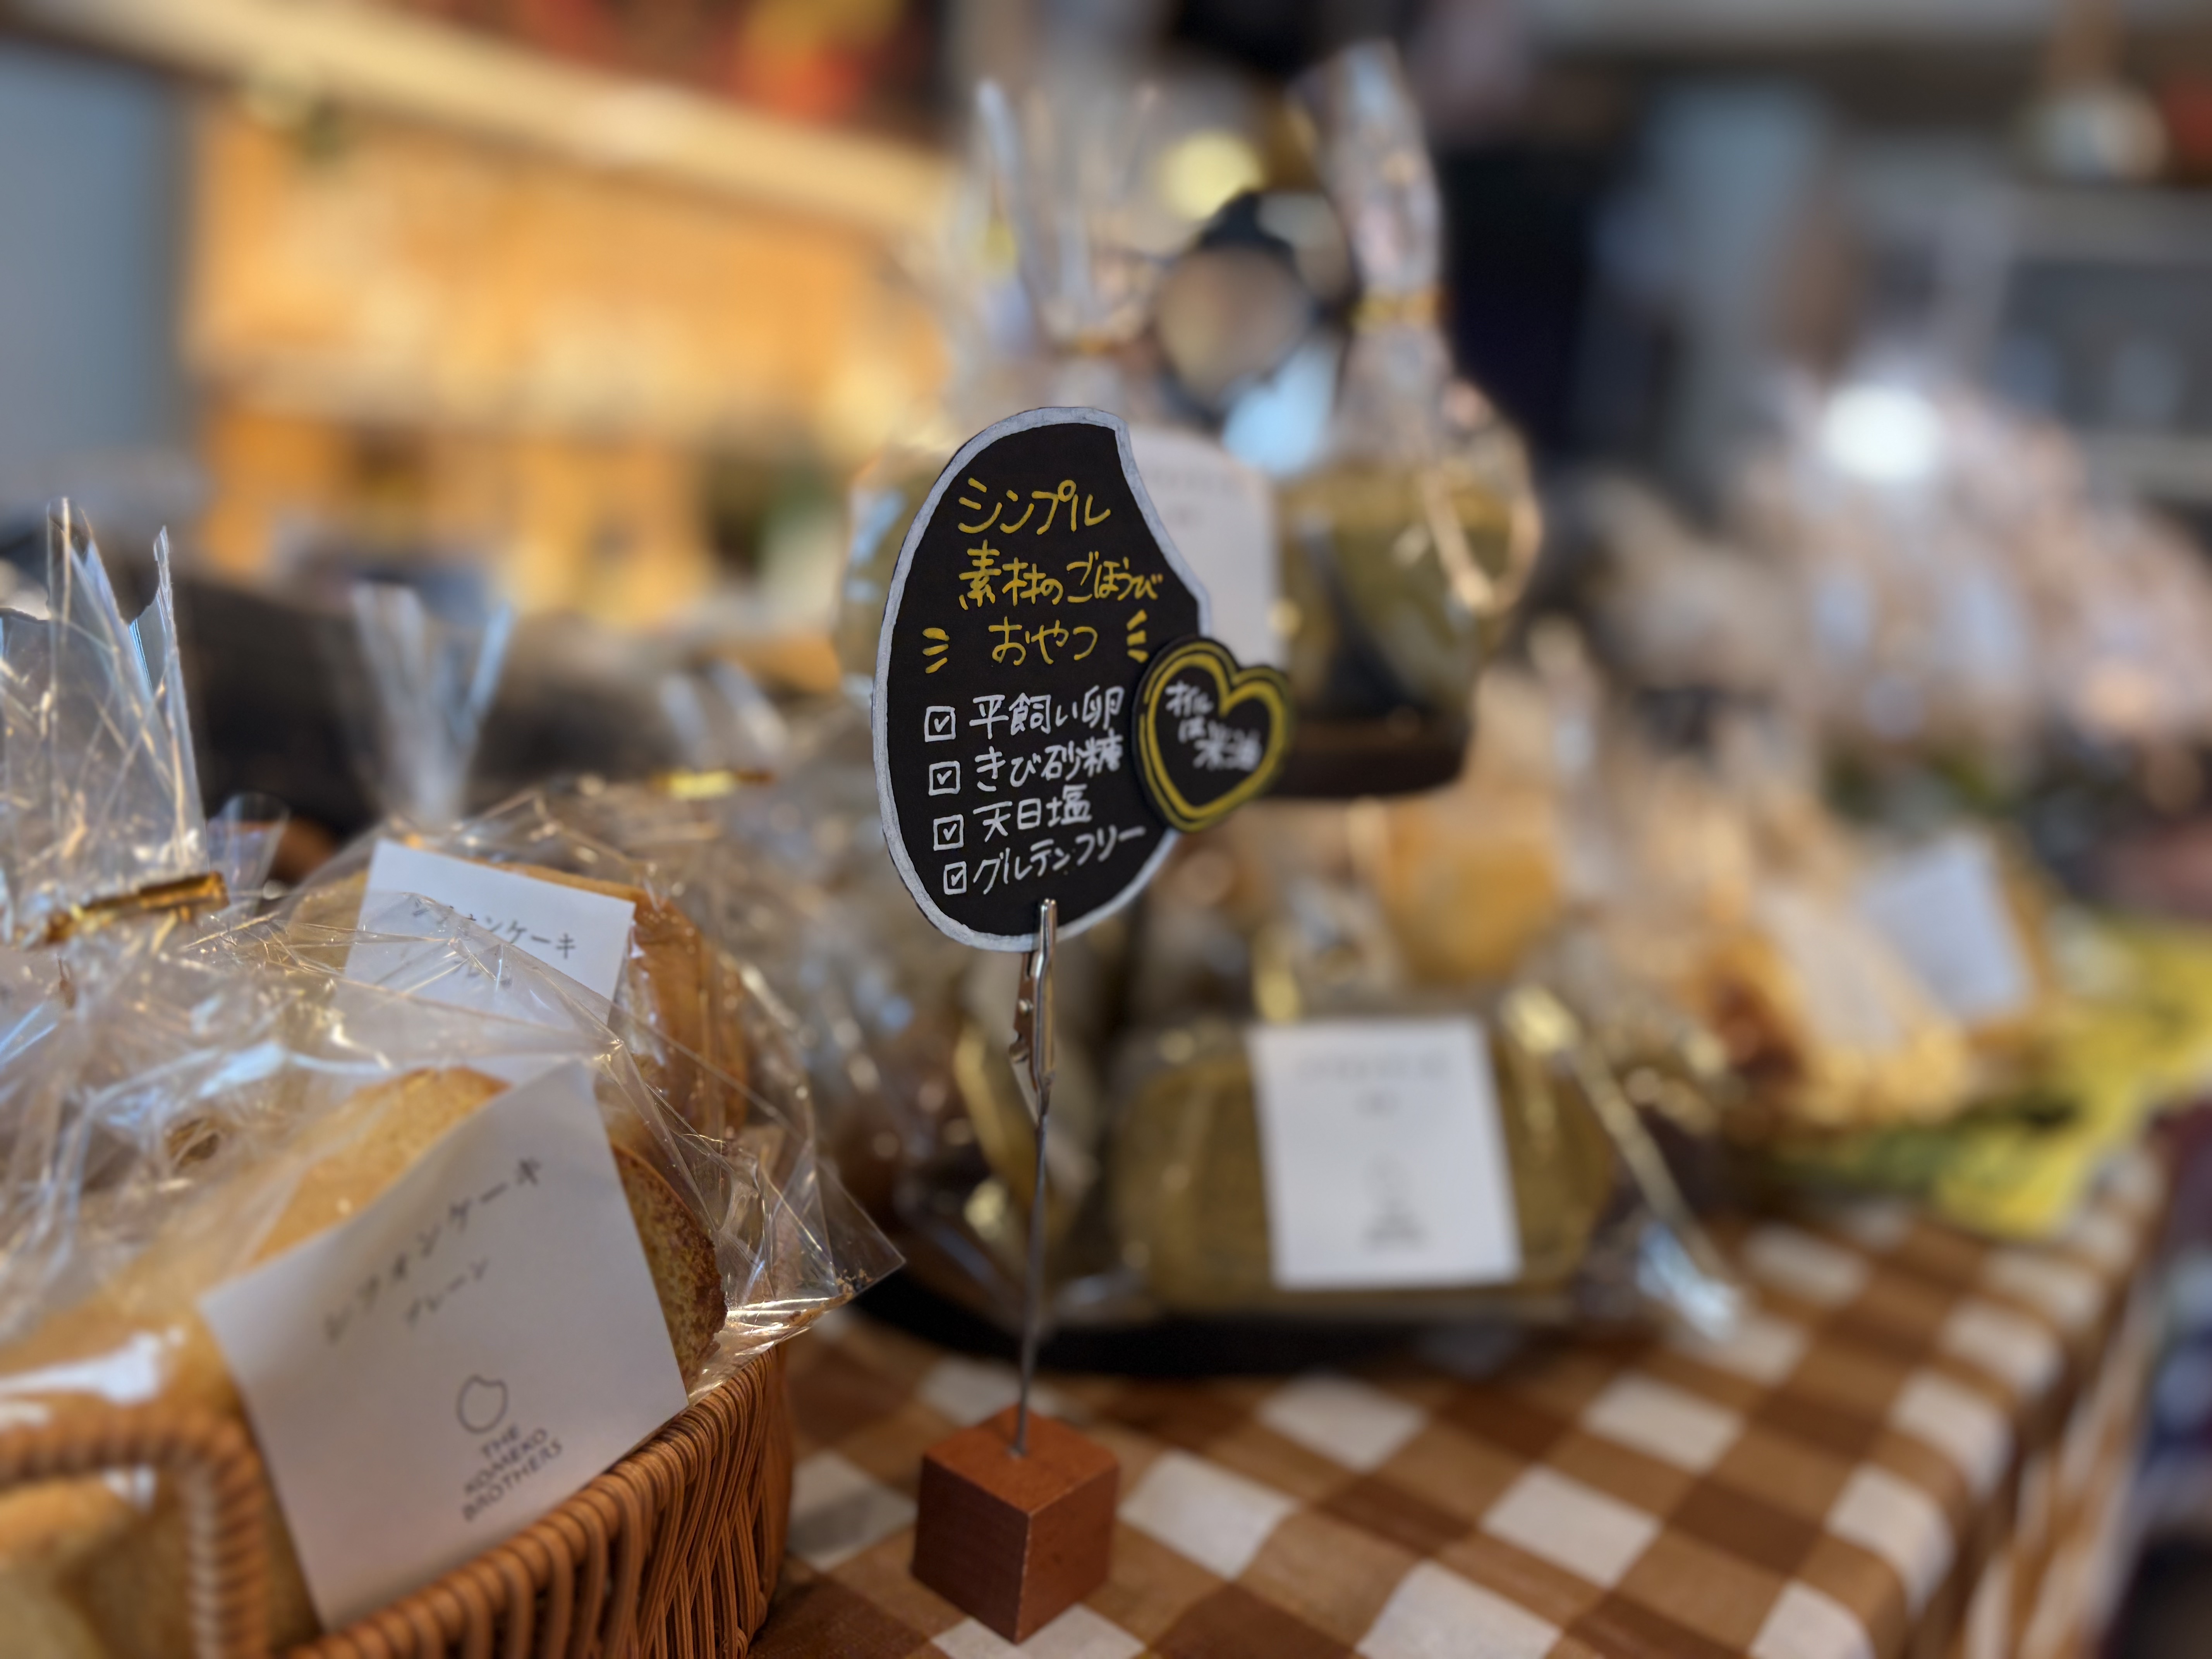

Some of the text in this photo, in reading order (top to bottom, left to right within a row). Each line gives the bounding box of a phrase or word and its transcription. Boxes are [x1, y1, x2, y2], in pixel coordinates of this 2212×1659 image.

[958, 477, 1111, 535] シンプル
[959, 539, 1163, 610] 素材のごほうび
[988, 616, 1098, 666] おやつ
[969, 685, 1125, 739] 平飼い卵
[974, 728, 1123, 792] きび砂糖
[973, 783, 1092, 842] 天日塩
[973, 824, 1147, 895] グルテンフリー
[480, 1422, 520, 1460] THE
[462, 1437, 563, 1523] BROTHERS
